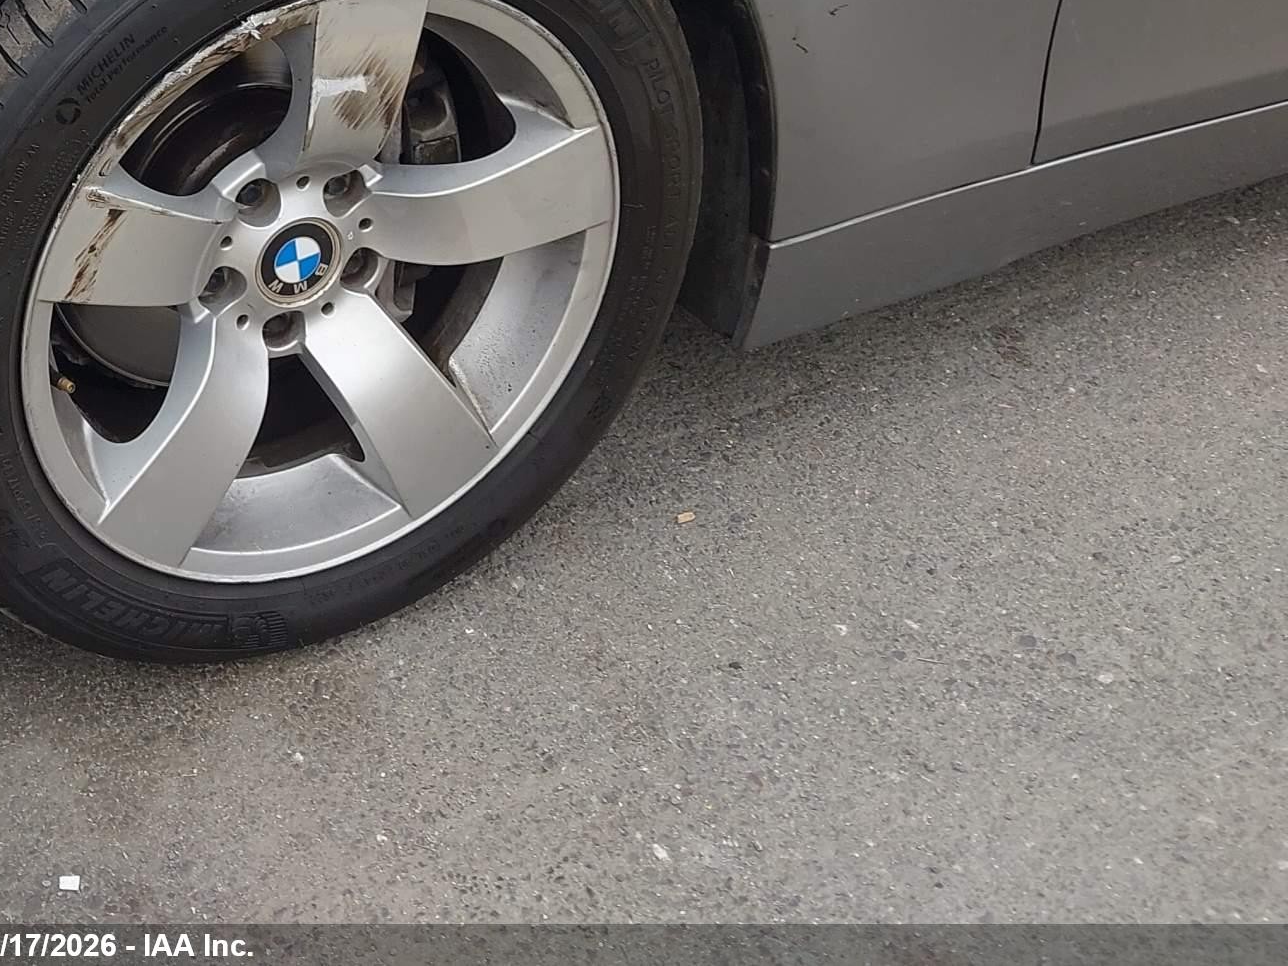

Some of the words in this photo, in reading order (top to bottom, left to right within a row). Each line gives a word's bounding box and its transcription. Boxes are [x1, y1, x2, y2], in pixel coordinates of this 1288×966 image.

[76, 32, 136, 96] MICHELIN
[640, 57, 676, 116] PILOT
[663, 125, 682, 202] SPORT
[268, 262, 328, 294] BMW
[41, 566, 222, 644] MICHELIN
